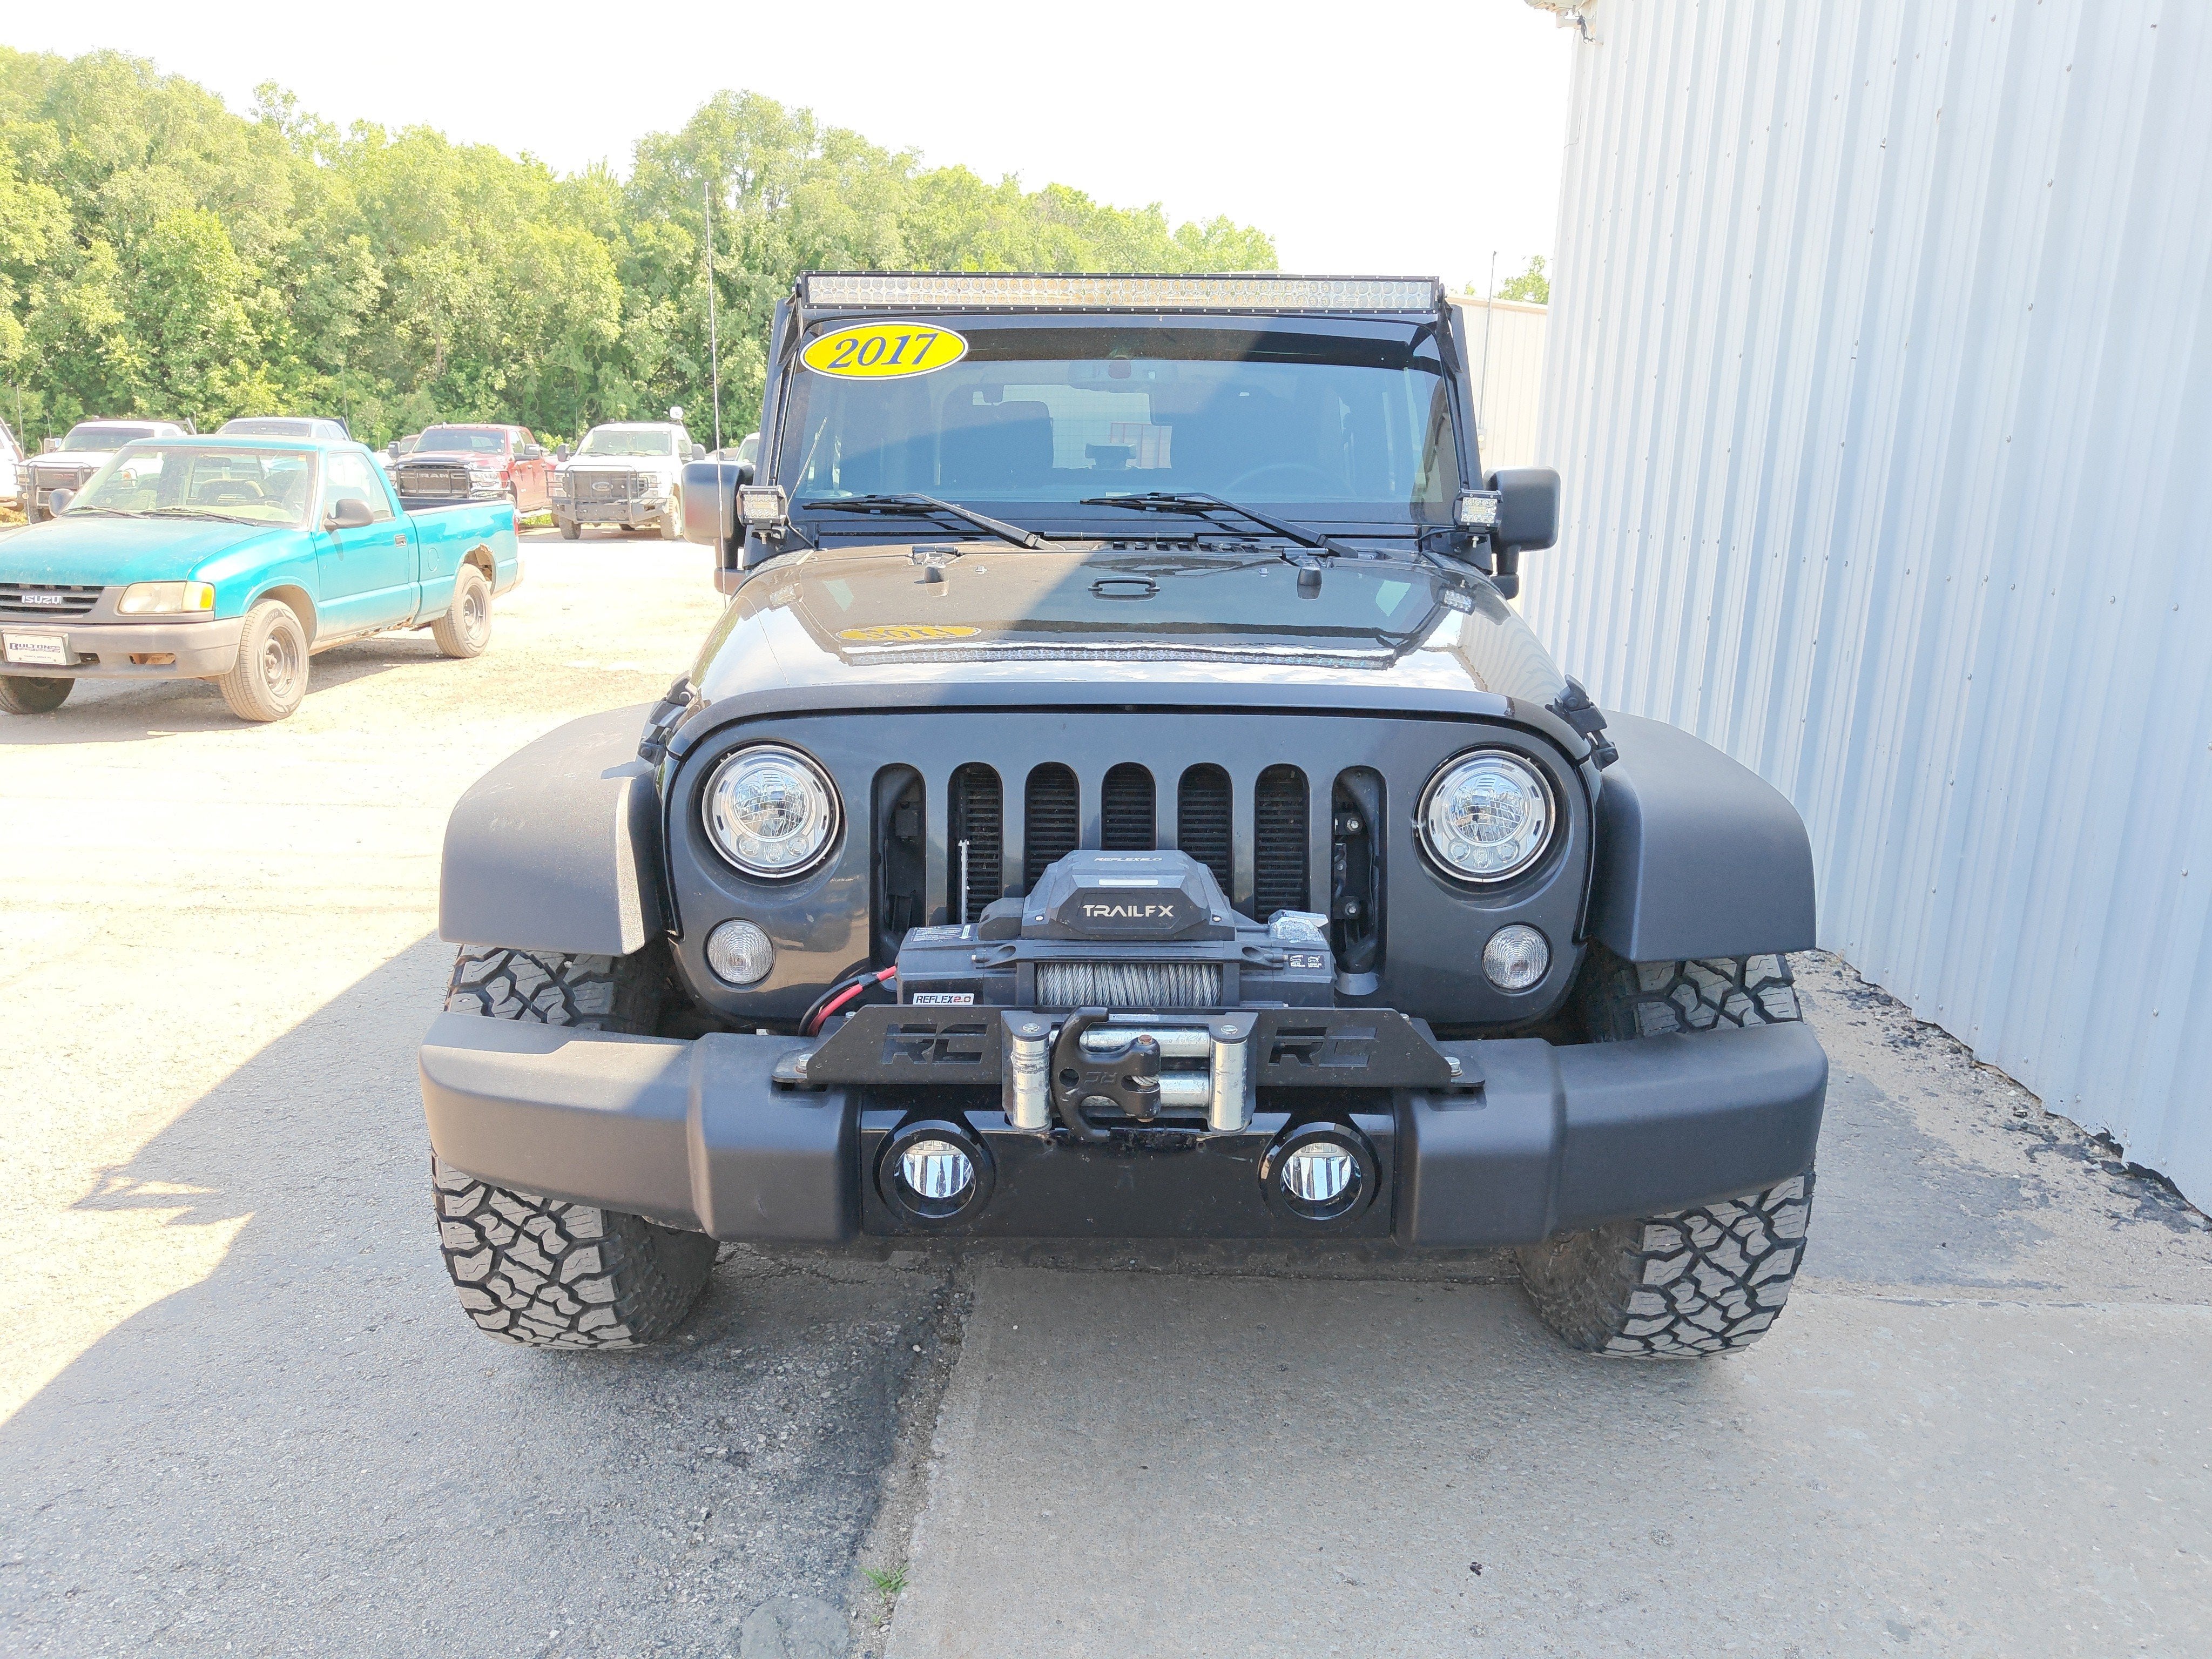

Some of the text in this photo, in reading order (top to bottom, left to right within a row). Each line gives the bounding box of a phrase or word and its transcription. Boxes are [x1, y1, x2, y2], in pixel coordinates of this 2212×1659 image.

[827, 333, 939, 369] 2017
[22, 595, 62, 604] ISUZU
[1082, 905, 1174, 918] TRAILFX
[881, 1023, 988, 1064] RC
[1267, 1027, 1378, 1067] RC
